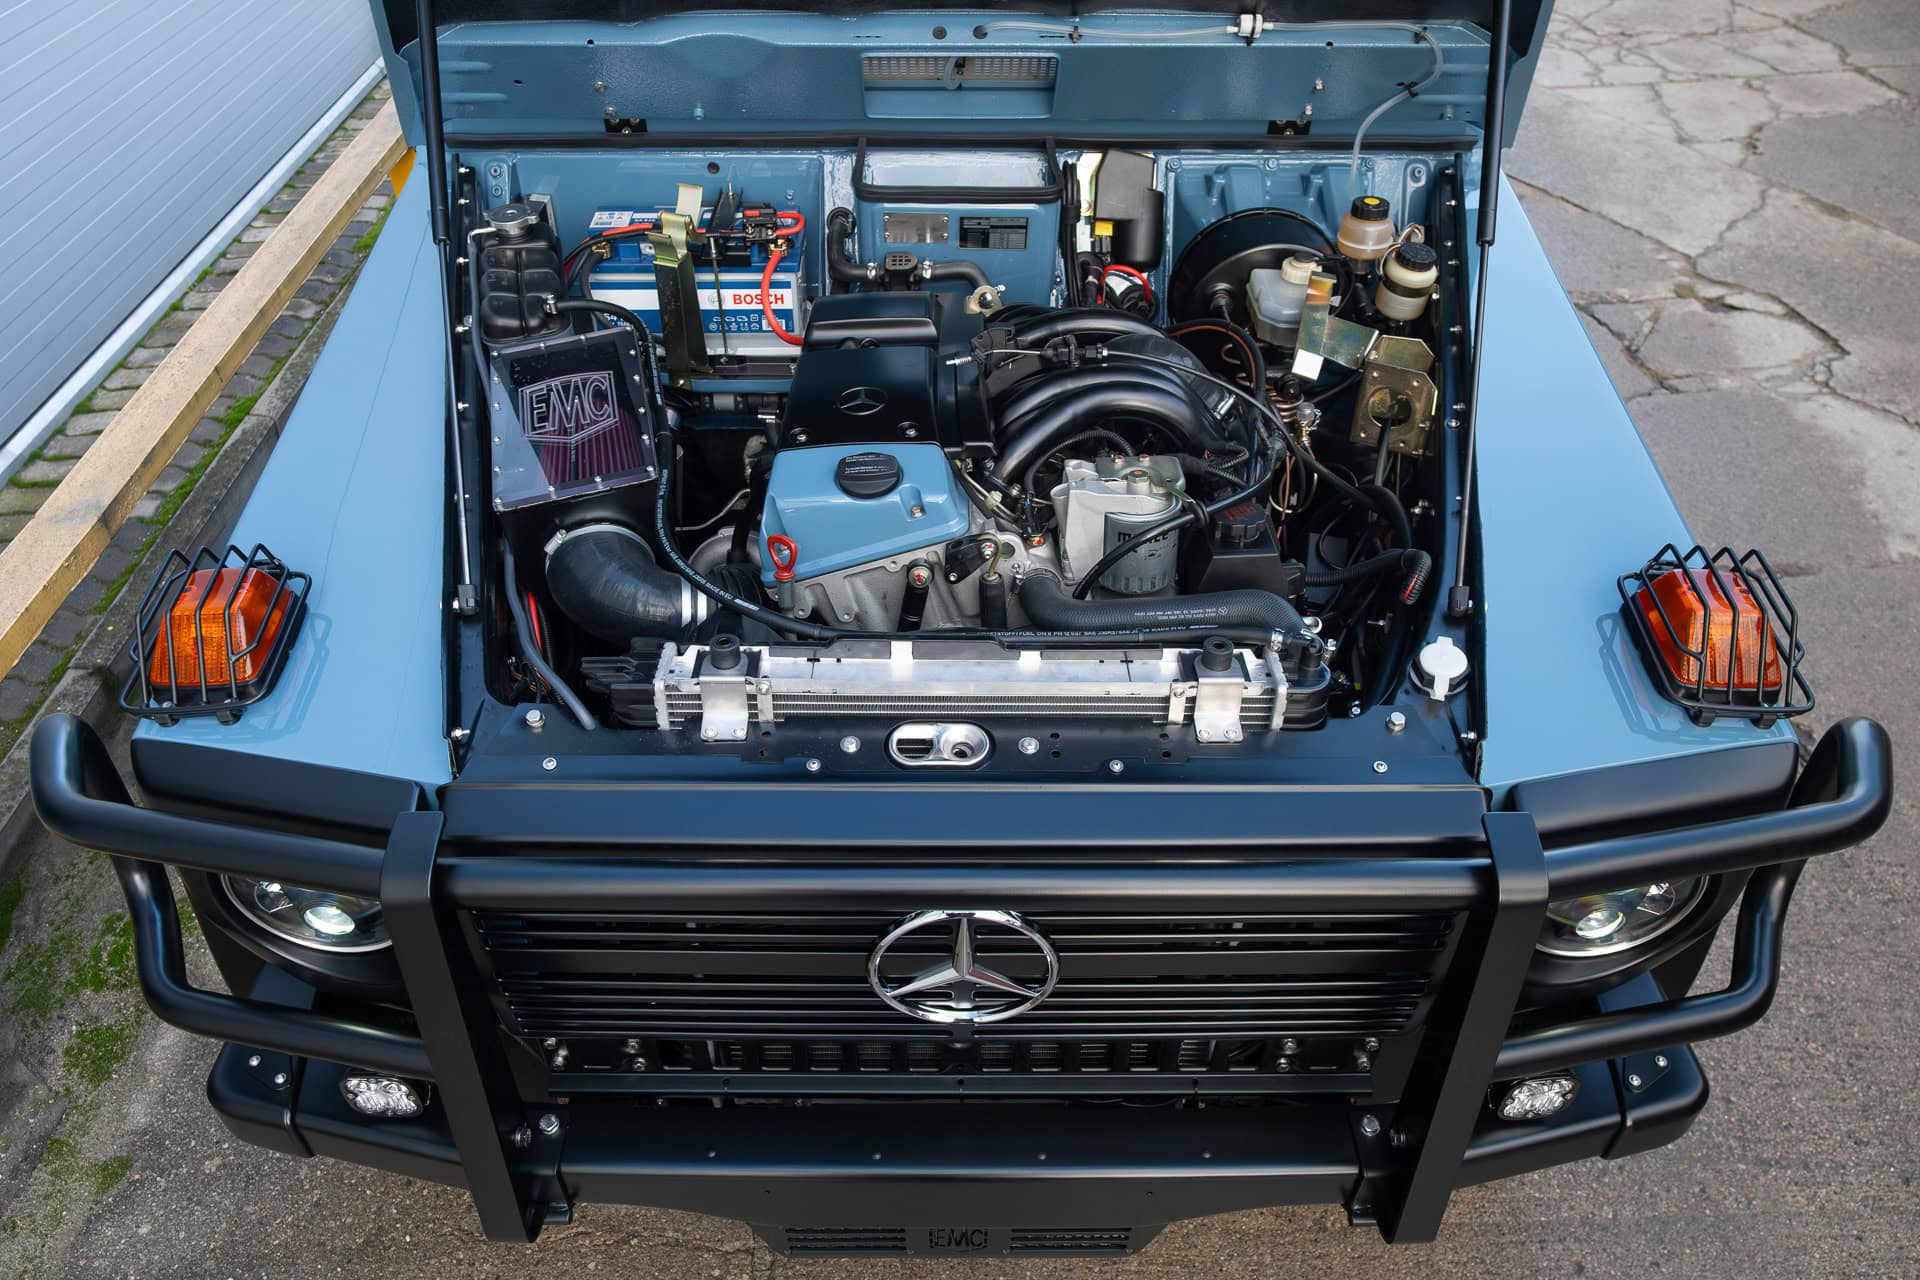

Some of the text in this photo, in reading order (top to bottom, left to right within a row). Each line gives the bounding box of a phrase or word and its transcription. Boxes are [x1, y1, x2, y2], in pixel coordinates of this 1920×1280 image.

[733, 293, 784, 305] BOSH
[523, 375, 611, 436] EMC
[934, 1228, 984, 1248] EMC
